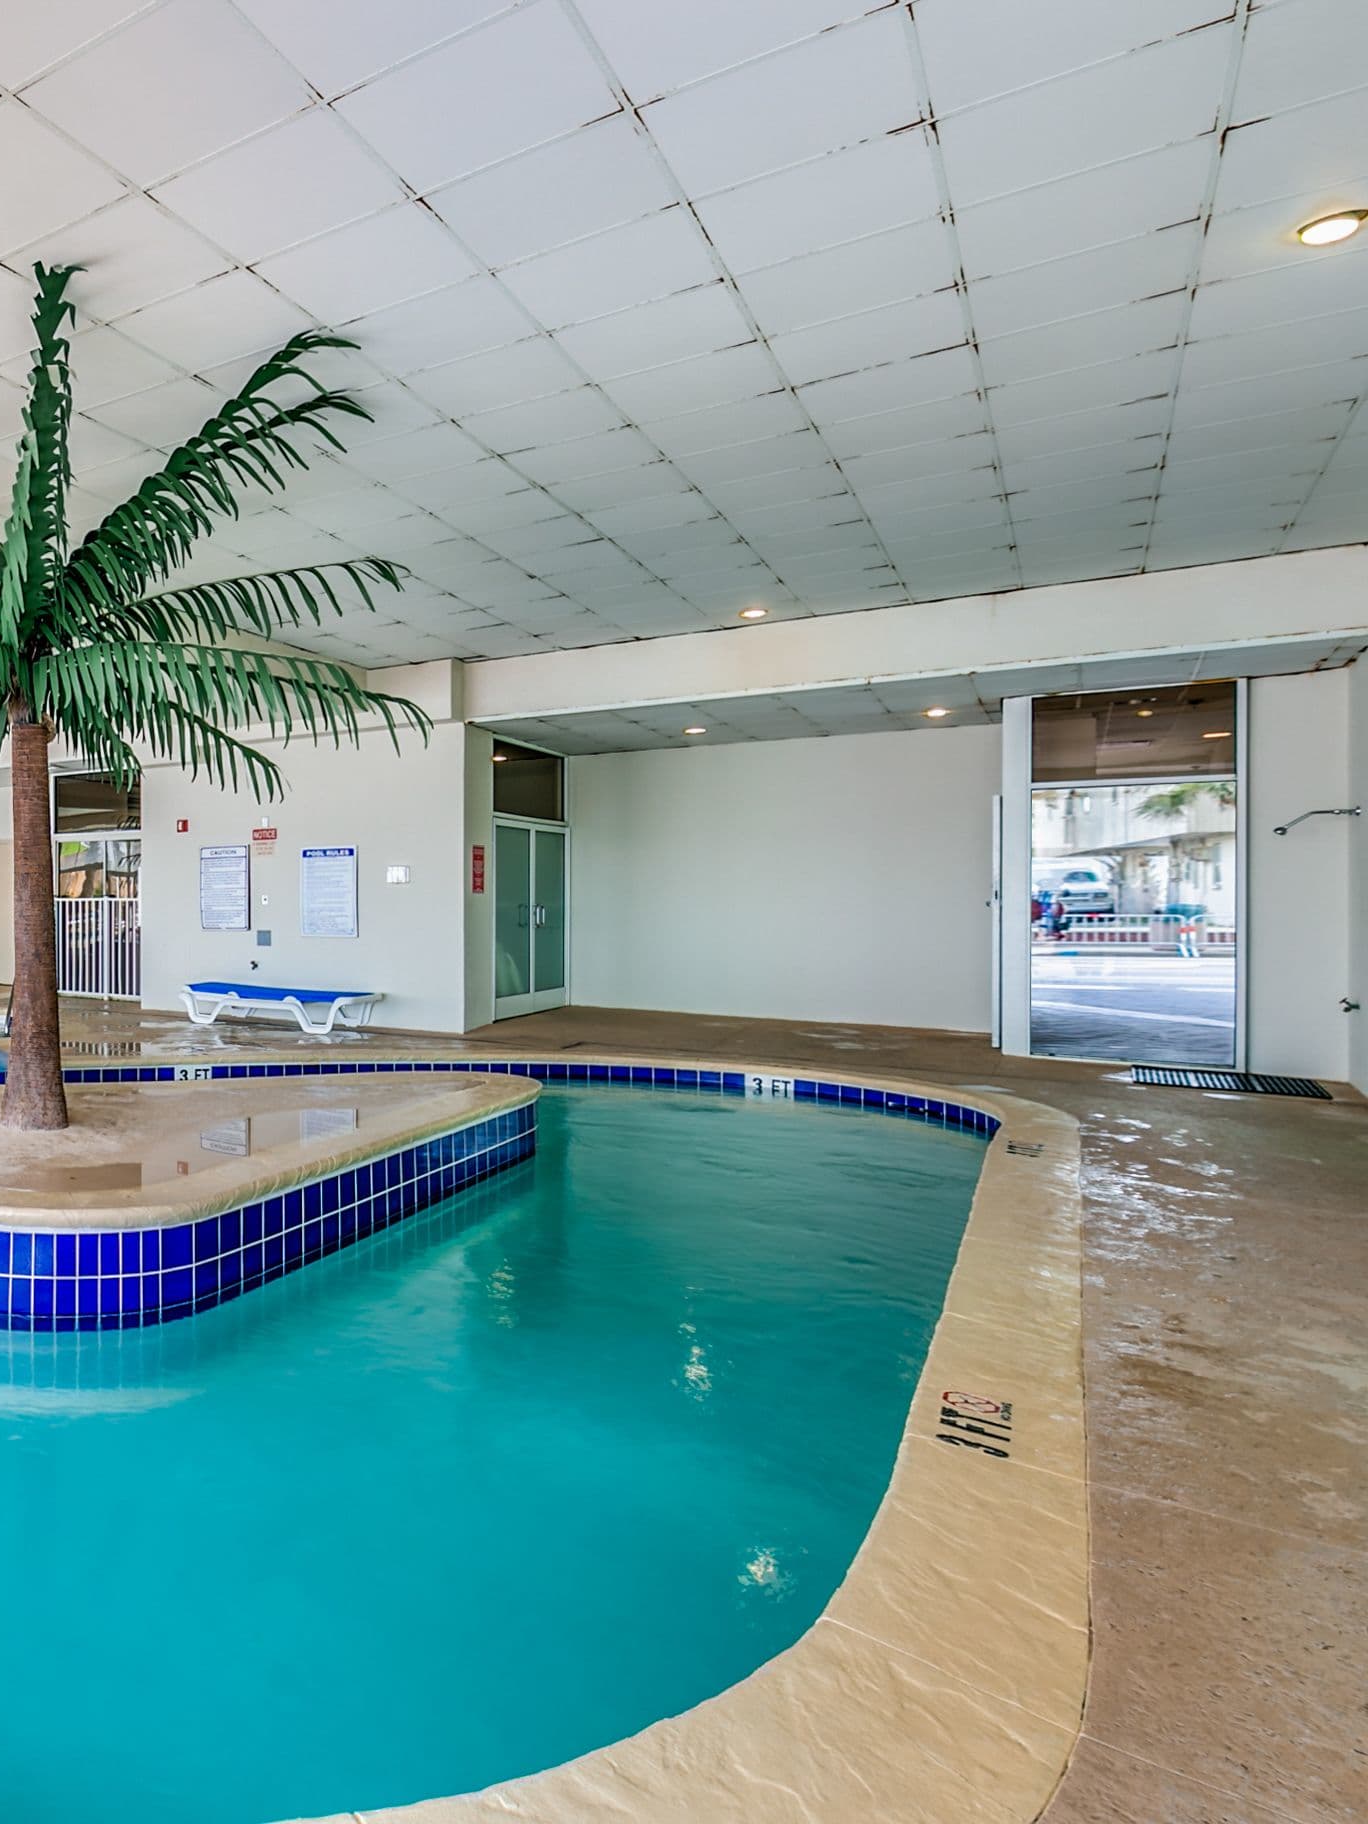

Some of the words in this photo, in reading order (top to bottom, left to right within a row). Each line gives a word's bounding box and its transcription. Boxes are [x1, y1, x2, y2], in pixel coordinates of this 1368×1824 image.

[253, 829, 277, 840] NOTICE
[179, 1069, 188, 1080] 3
[194, 1068, 210, 1081] FT
[752, 1077, 762, 1096] 3
[772, 1079, 791, 1098] FT
[939, 1406, 1013, 1443] FT
[935, 1433, 1010, 1458] 3
